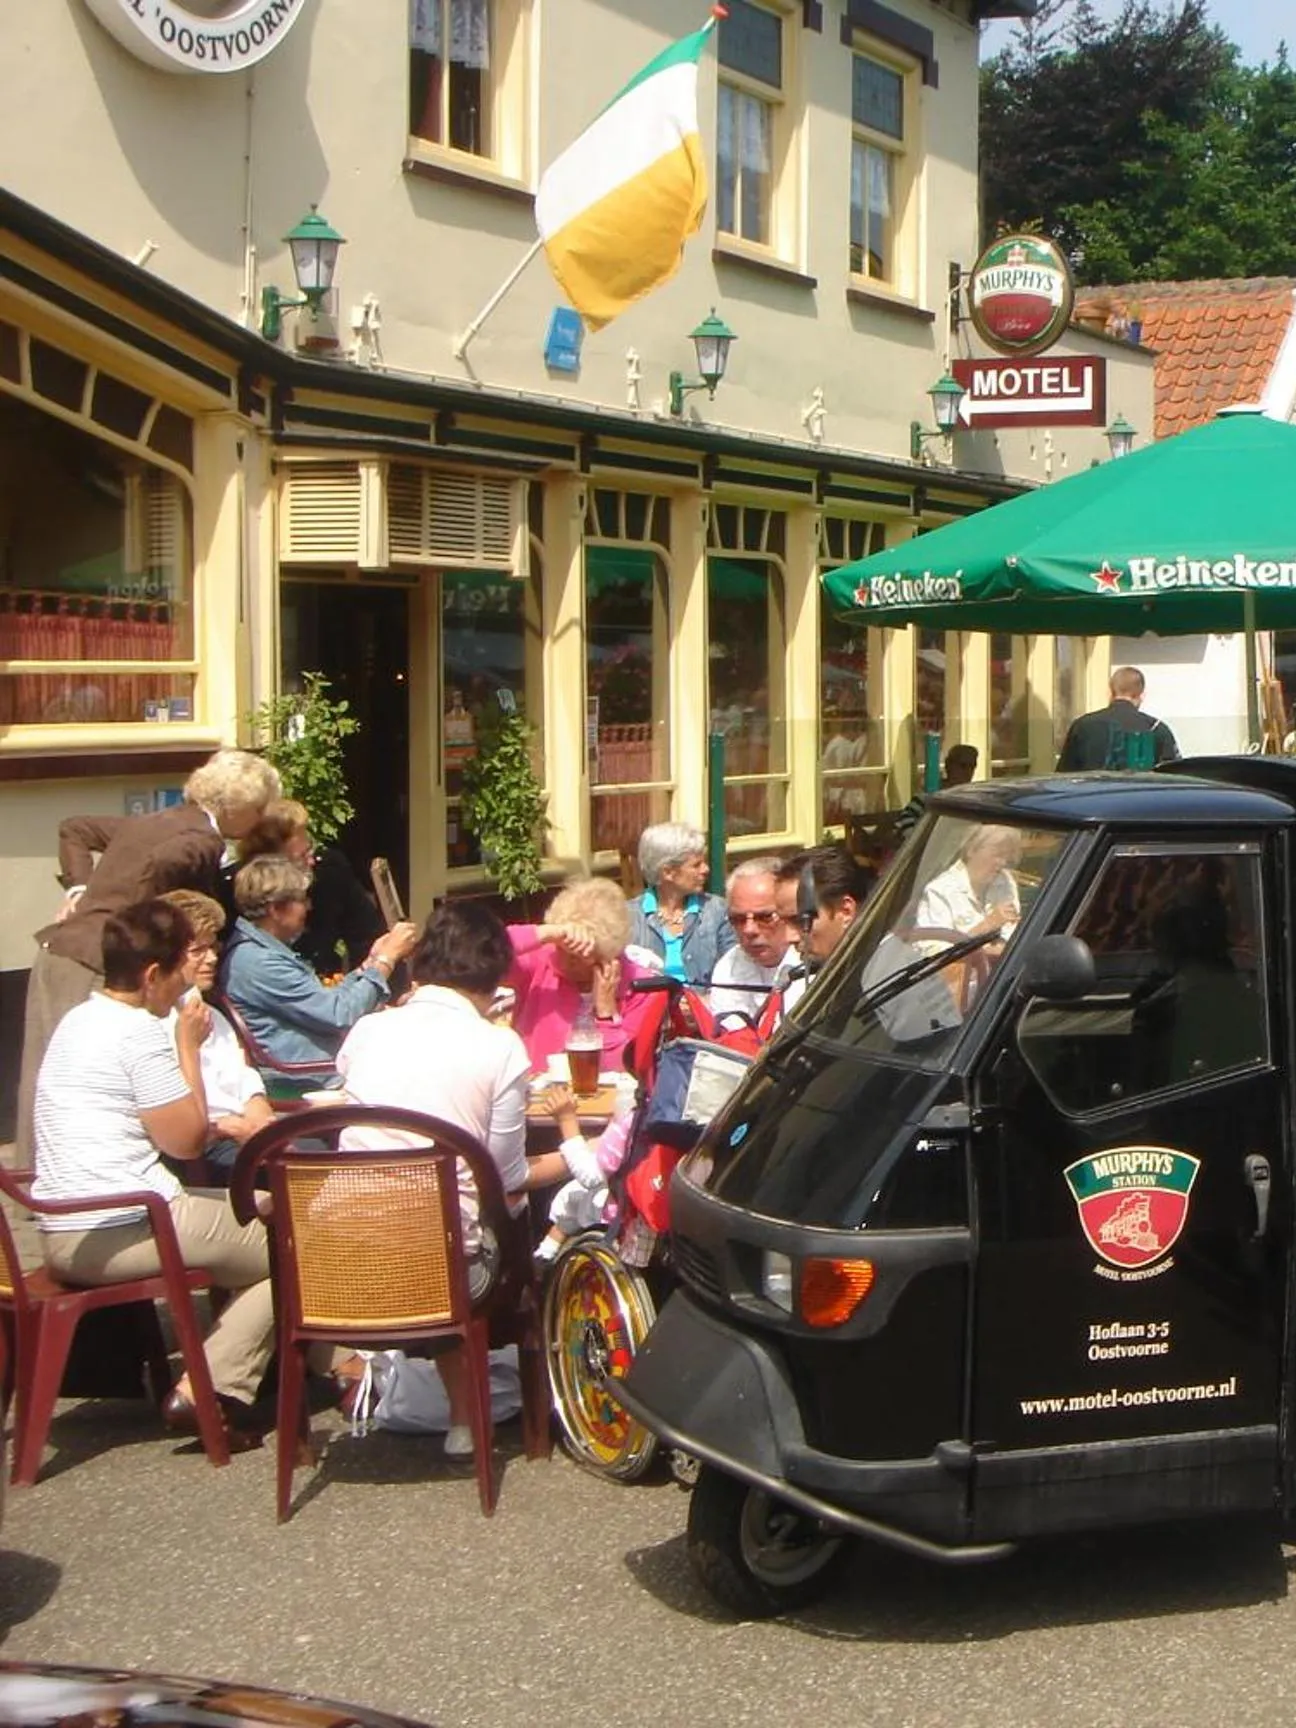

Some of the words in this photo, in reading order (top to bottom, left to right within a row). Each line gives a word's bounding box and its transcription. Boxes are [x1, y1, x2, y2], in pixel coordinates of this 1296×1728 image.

[973, 367, 1080, 397] MOTEL
[871, 570, 963, 606] Heineken
[1112, 1174, 1157, 1188] STATION
[1089, 1322, 1145, 1341] Hoflaan
[1147, 1321, 1170, 1339] 3-5
[1088, 1341, 1169, 1361] Oostvoorne
[1020, 1376, 1237, 1415] www.motel-oostvoorne.nl
